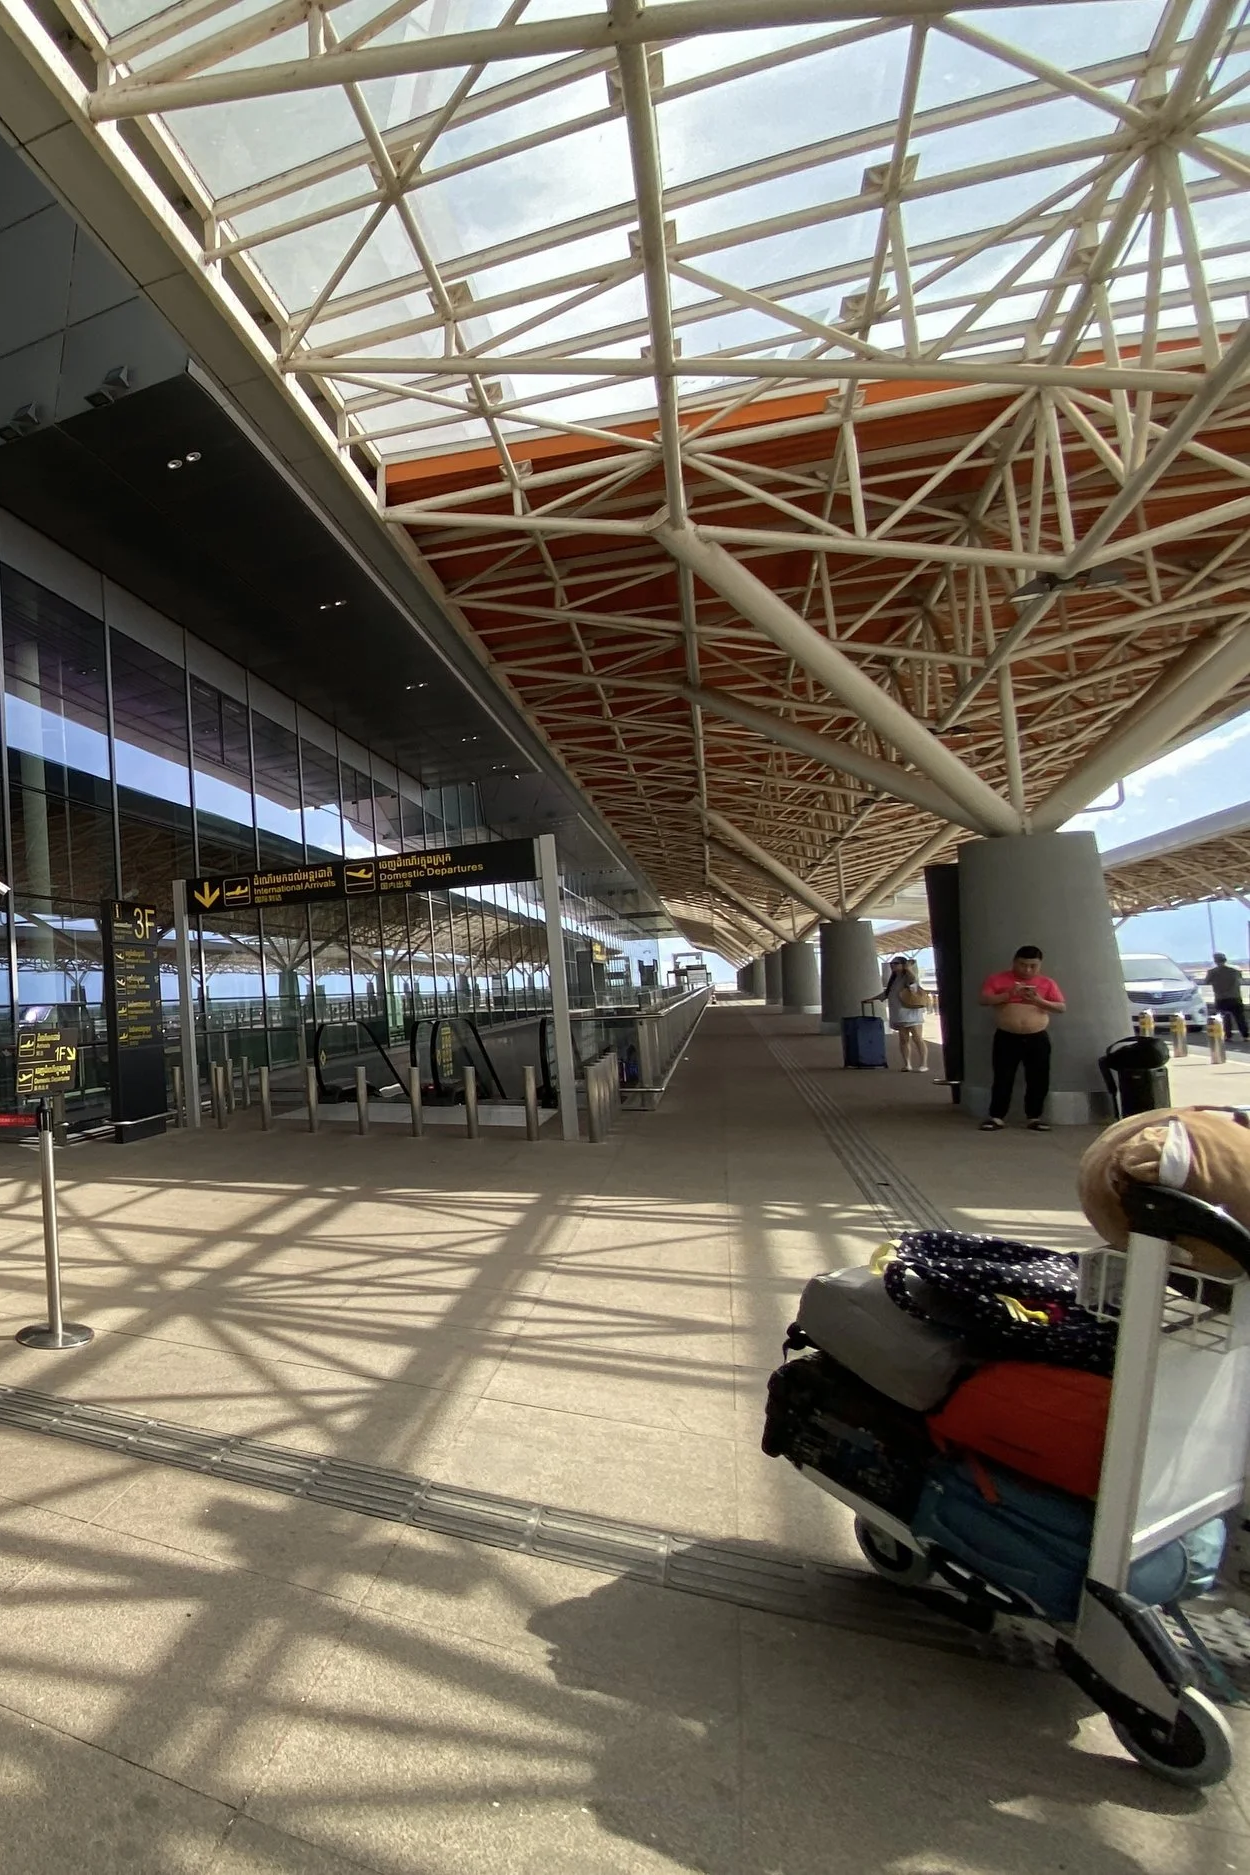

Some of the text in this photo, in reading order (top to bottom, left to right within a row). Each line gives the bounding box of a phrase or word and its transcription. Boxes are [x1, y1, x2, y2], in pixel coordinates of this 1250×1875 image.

[379, 863, 484, 882] Domestic Departures
[253, 879, 336, 895] International Arrivals
[133, 907, 155, 939] 3F
[54, 1046, 67, 1062] 1F
